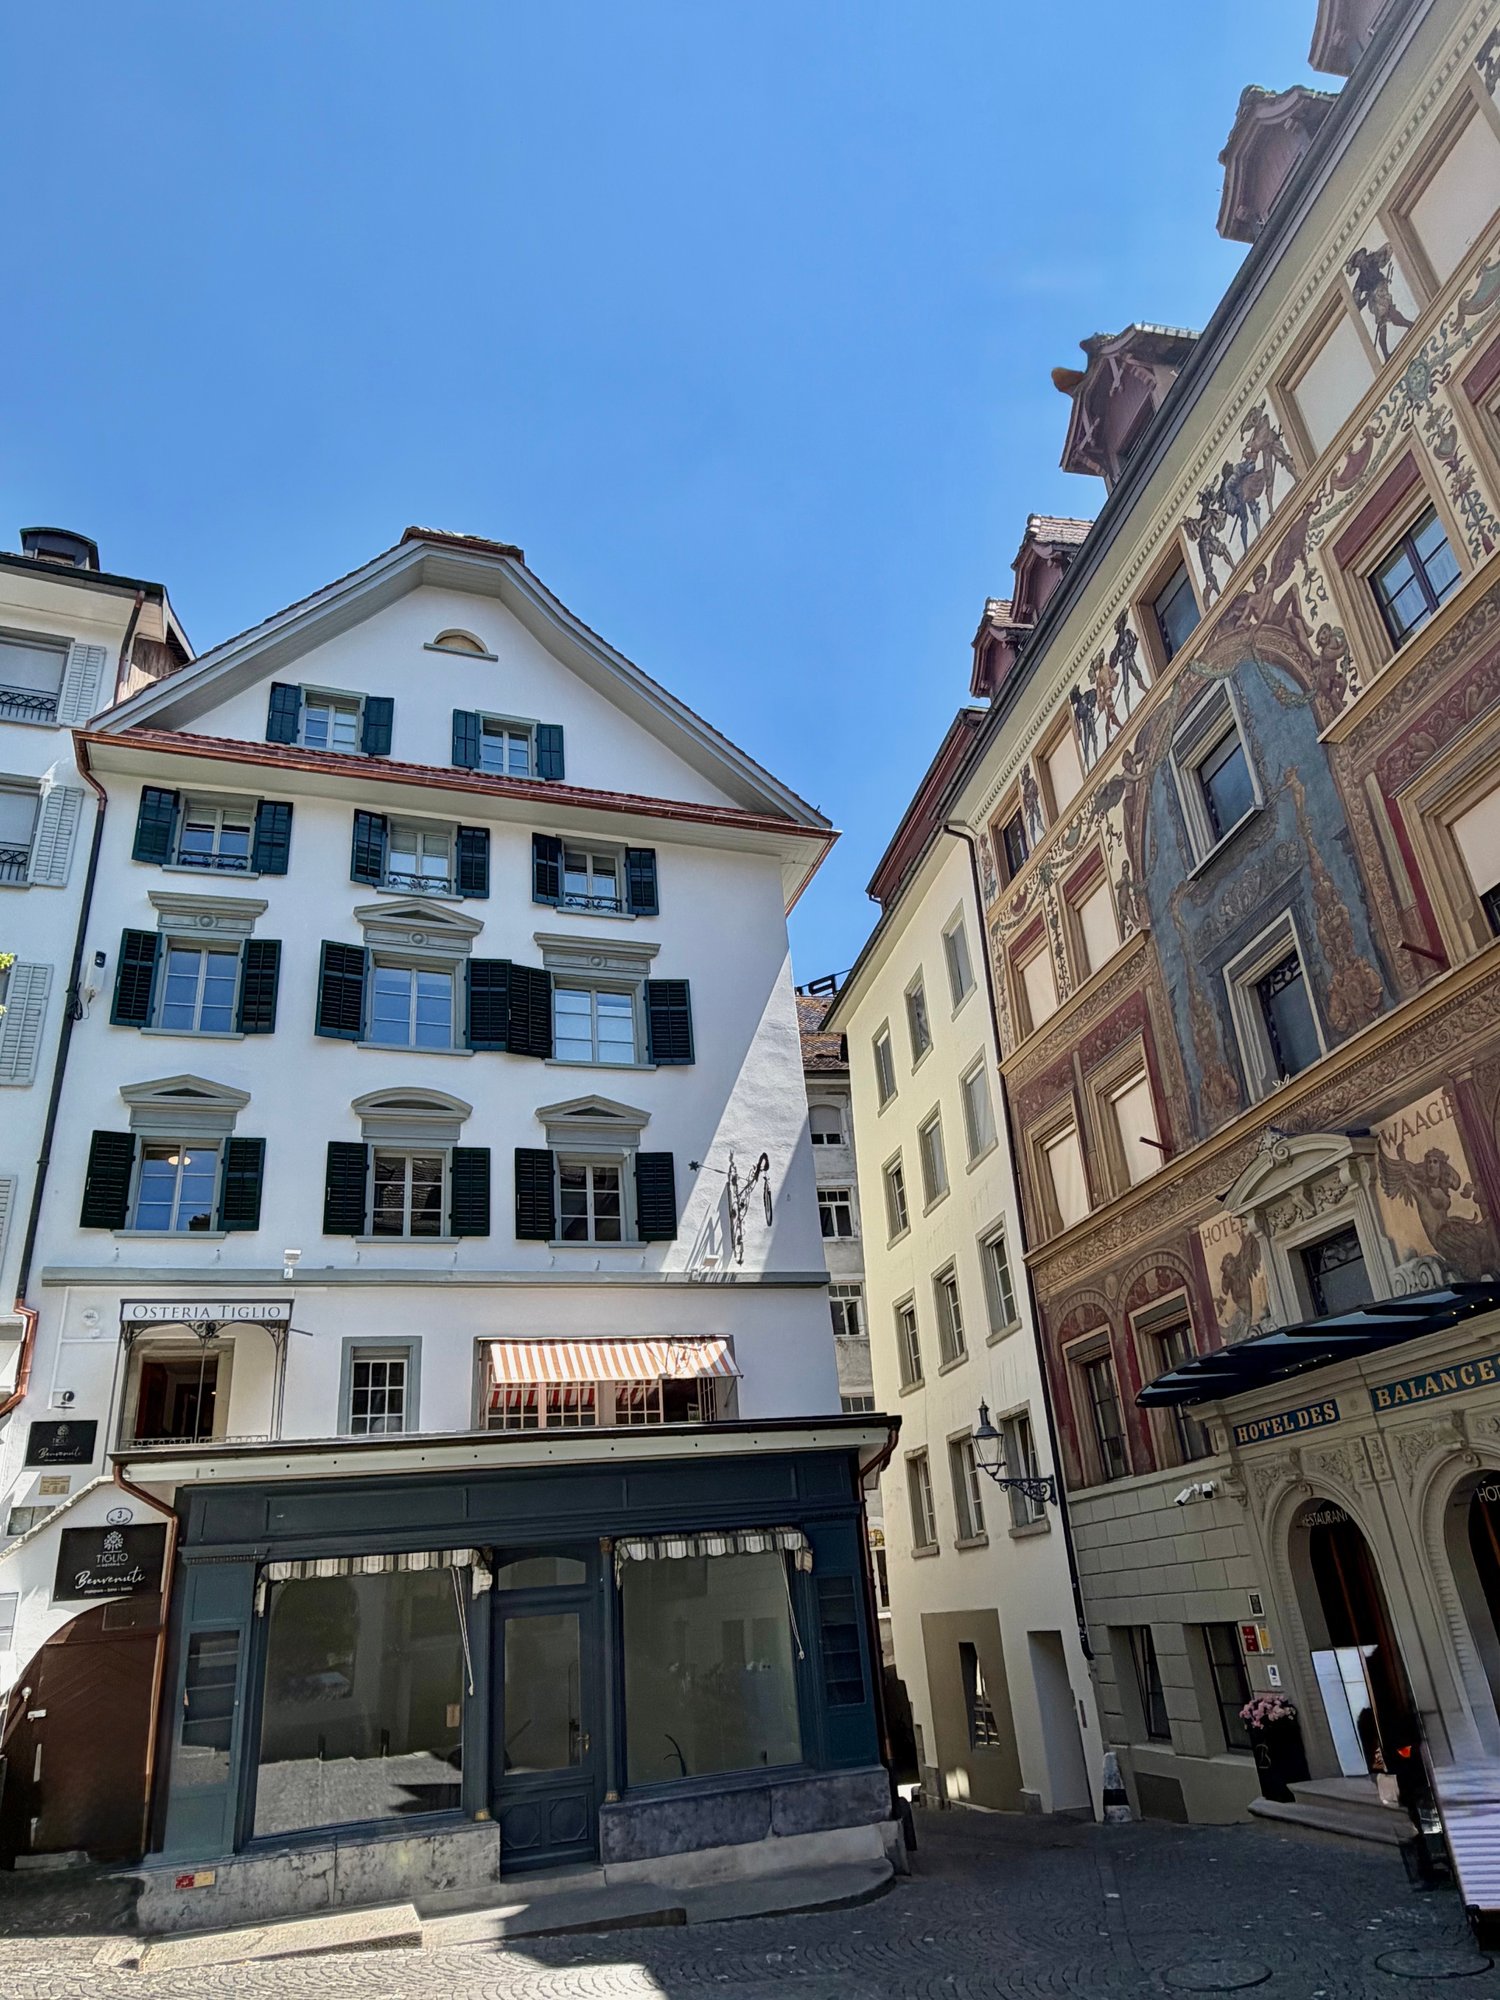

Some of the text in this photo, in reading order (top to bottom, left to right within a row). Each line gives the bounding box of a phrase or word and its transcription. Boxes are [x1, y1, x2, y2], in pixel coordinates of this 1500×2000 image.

[1380, 1093, 1459, 1149] WAAGE
[1201, 1215, 1248, 1249] HOTEL
[132, 1304, 281, 1319] OSTERIA TIGLIO
[1236, 1356, 1500, 1444] HOTEL DES BALANCE
[117, 1510, 123, 1519] 3
[96, 1552, 129, 1564] TIGLIO
[75, 1565, 145, 1590] Benvenuti
